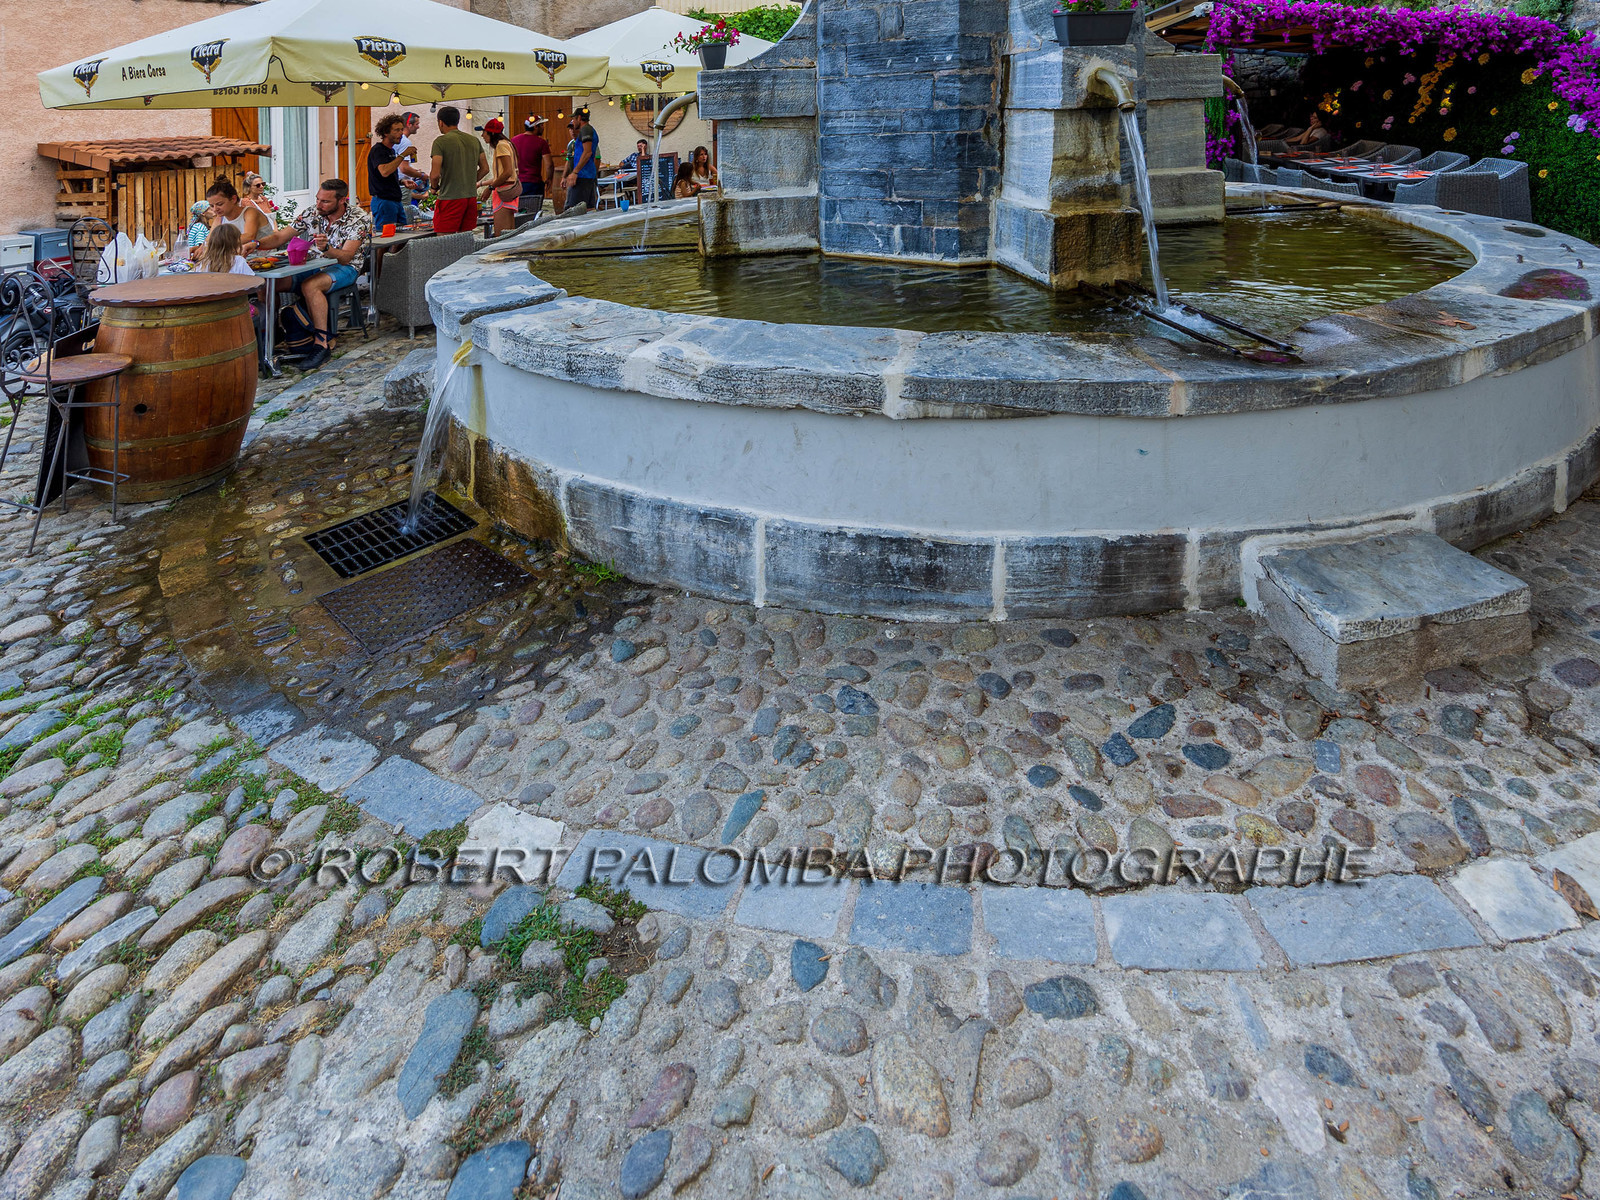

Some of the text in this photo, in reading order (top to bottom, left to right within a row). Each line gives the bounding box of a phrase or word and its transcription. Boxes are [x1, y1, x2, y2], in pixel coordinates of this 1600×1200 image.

[193, 43, 221, 59] Pietra
[361, 39, 402, 52] Pietra
[444, 54, 505, 70] A Biera Corsa
[537, 51, 565, 63] Pietra
[121, 63, 167, 81] A Biera Corsa
[645, 64, 672, 72] Pietra
